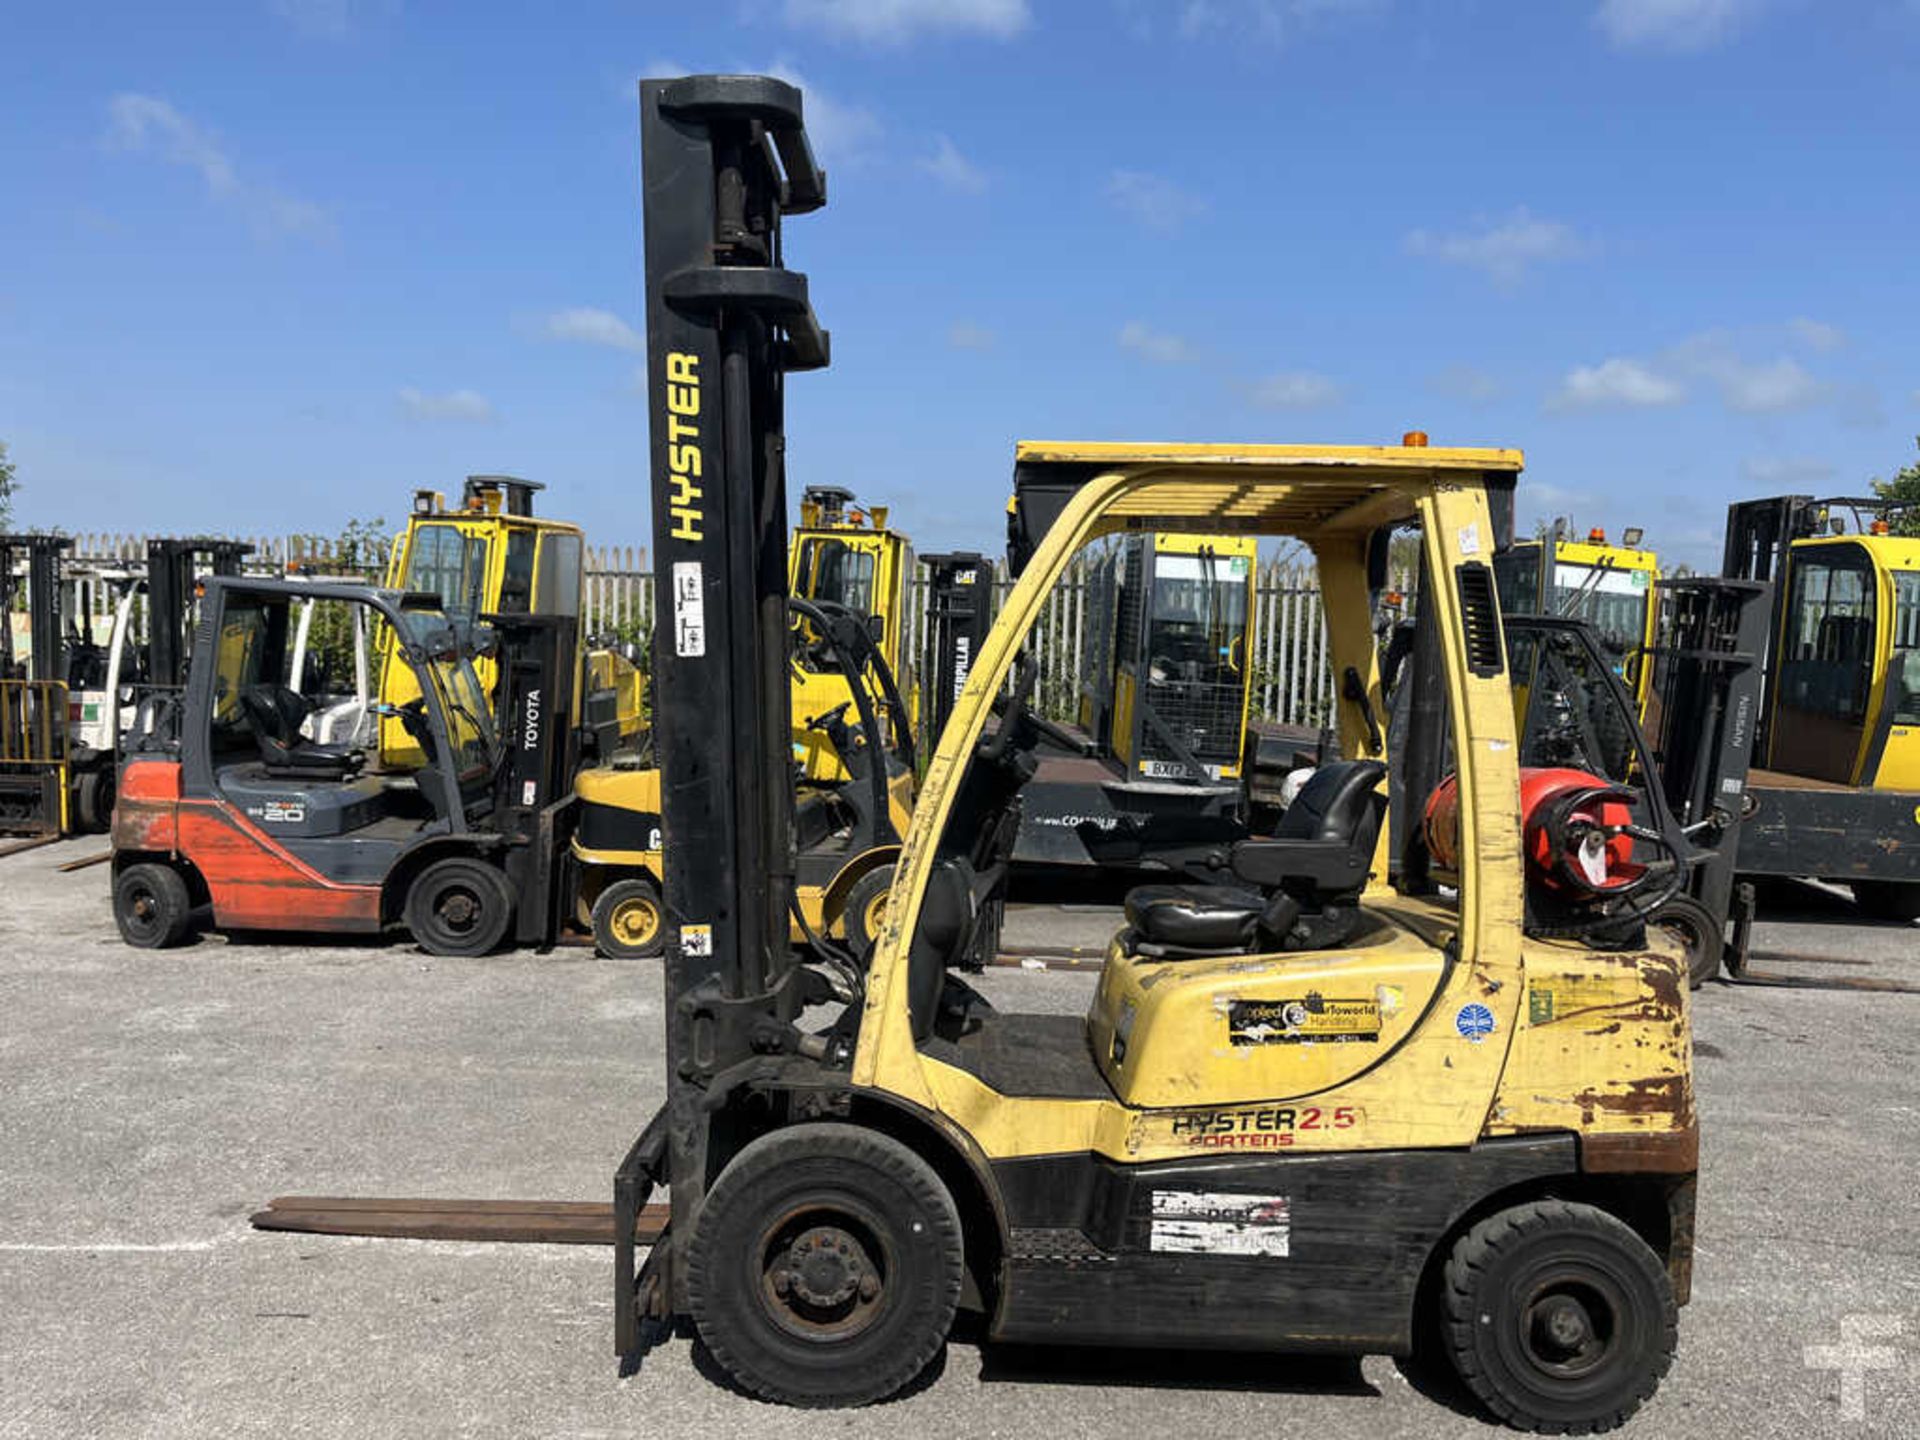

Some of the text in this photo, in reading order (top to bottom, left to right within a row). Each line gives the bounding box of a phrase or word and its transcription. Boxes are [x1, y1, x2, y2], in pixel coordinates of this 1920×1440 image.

[666, 352, 704, 541] HYSTER
[955, 570, 977, 584] CAT
[524, 689, 541, 751] TOYOTA
[264, 808, 304, 822] 20
[1172, 1106, 1356, 1135] HYSTER 2.5
